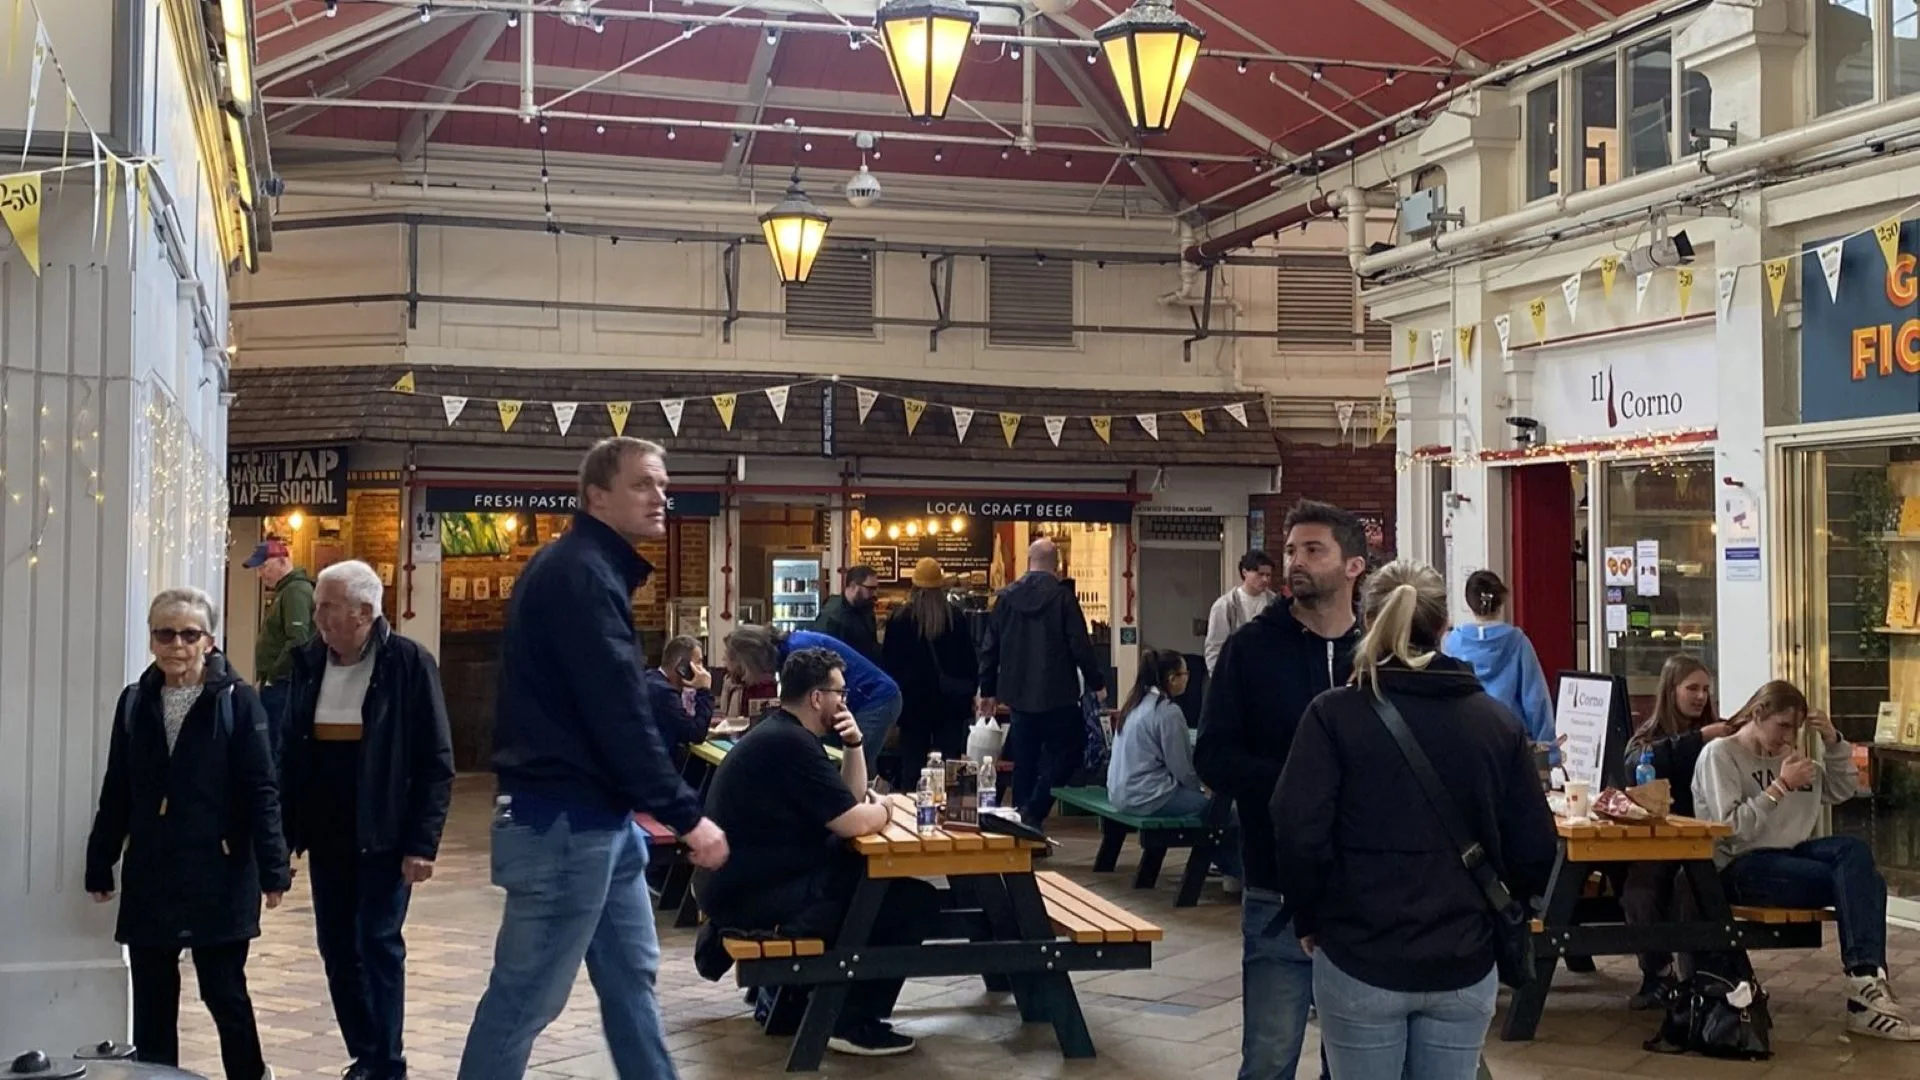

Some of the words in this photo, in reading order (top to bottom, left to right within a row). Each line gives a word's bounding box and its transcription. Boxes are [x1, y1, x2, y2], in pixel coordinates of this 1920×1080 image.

[0, 183, 38, 211] 250
[1877, 221, 1899, 242] 250
[1768, 264, 1787, 281] 250
[1591, 371, 1604, 401] Il
[1621, 391, 1682, 419] Corno
[231, 465, 278, 482] MARKET
[280, 450, 339, 480] TAP
[231, 483, 259, 505] TAP
[474, 495, 523, 507] FRESH
[926, 502, 976, 515] LOCAL
[981, 503, 1032, 516] CRAFT
[1036, 504, 1073, 517] BEER
